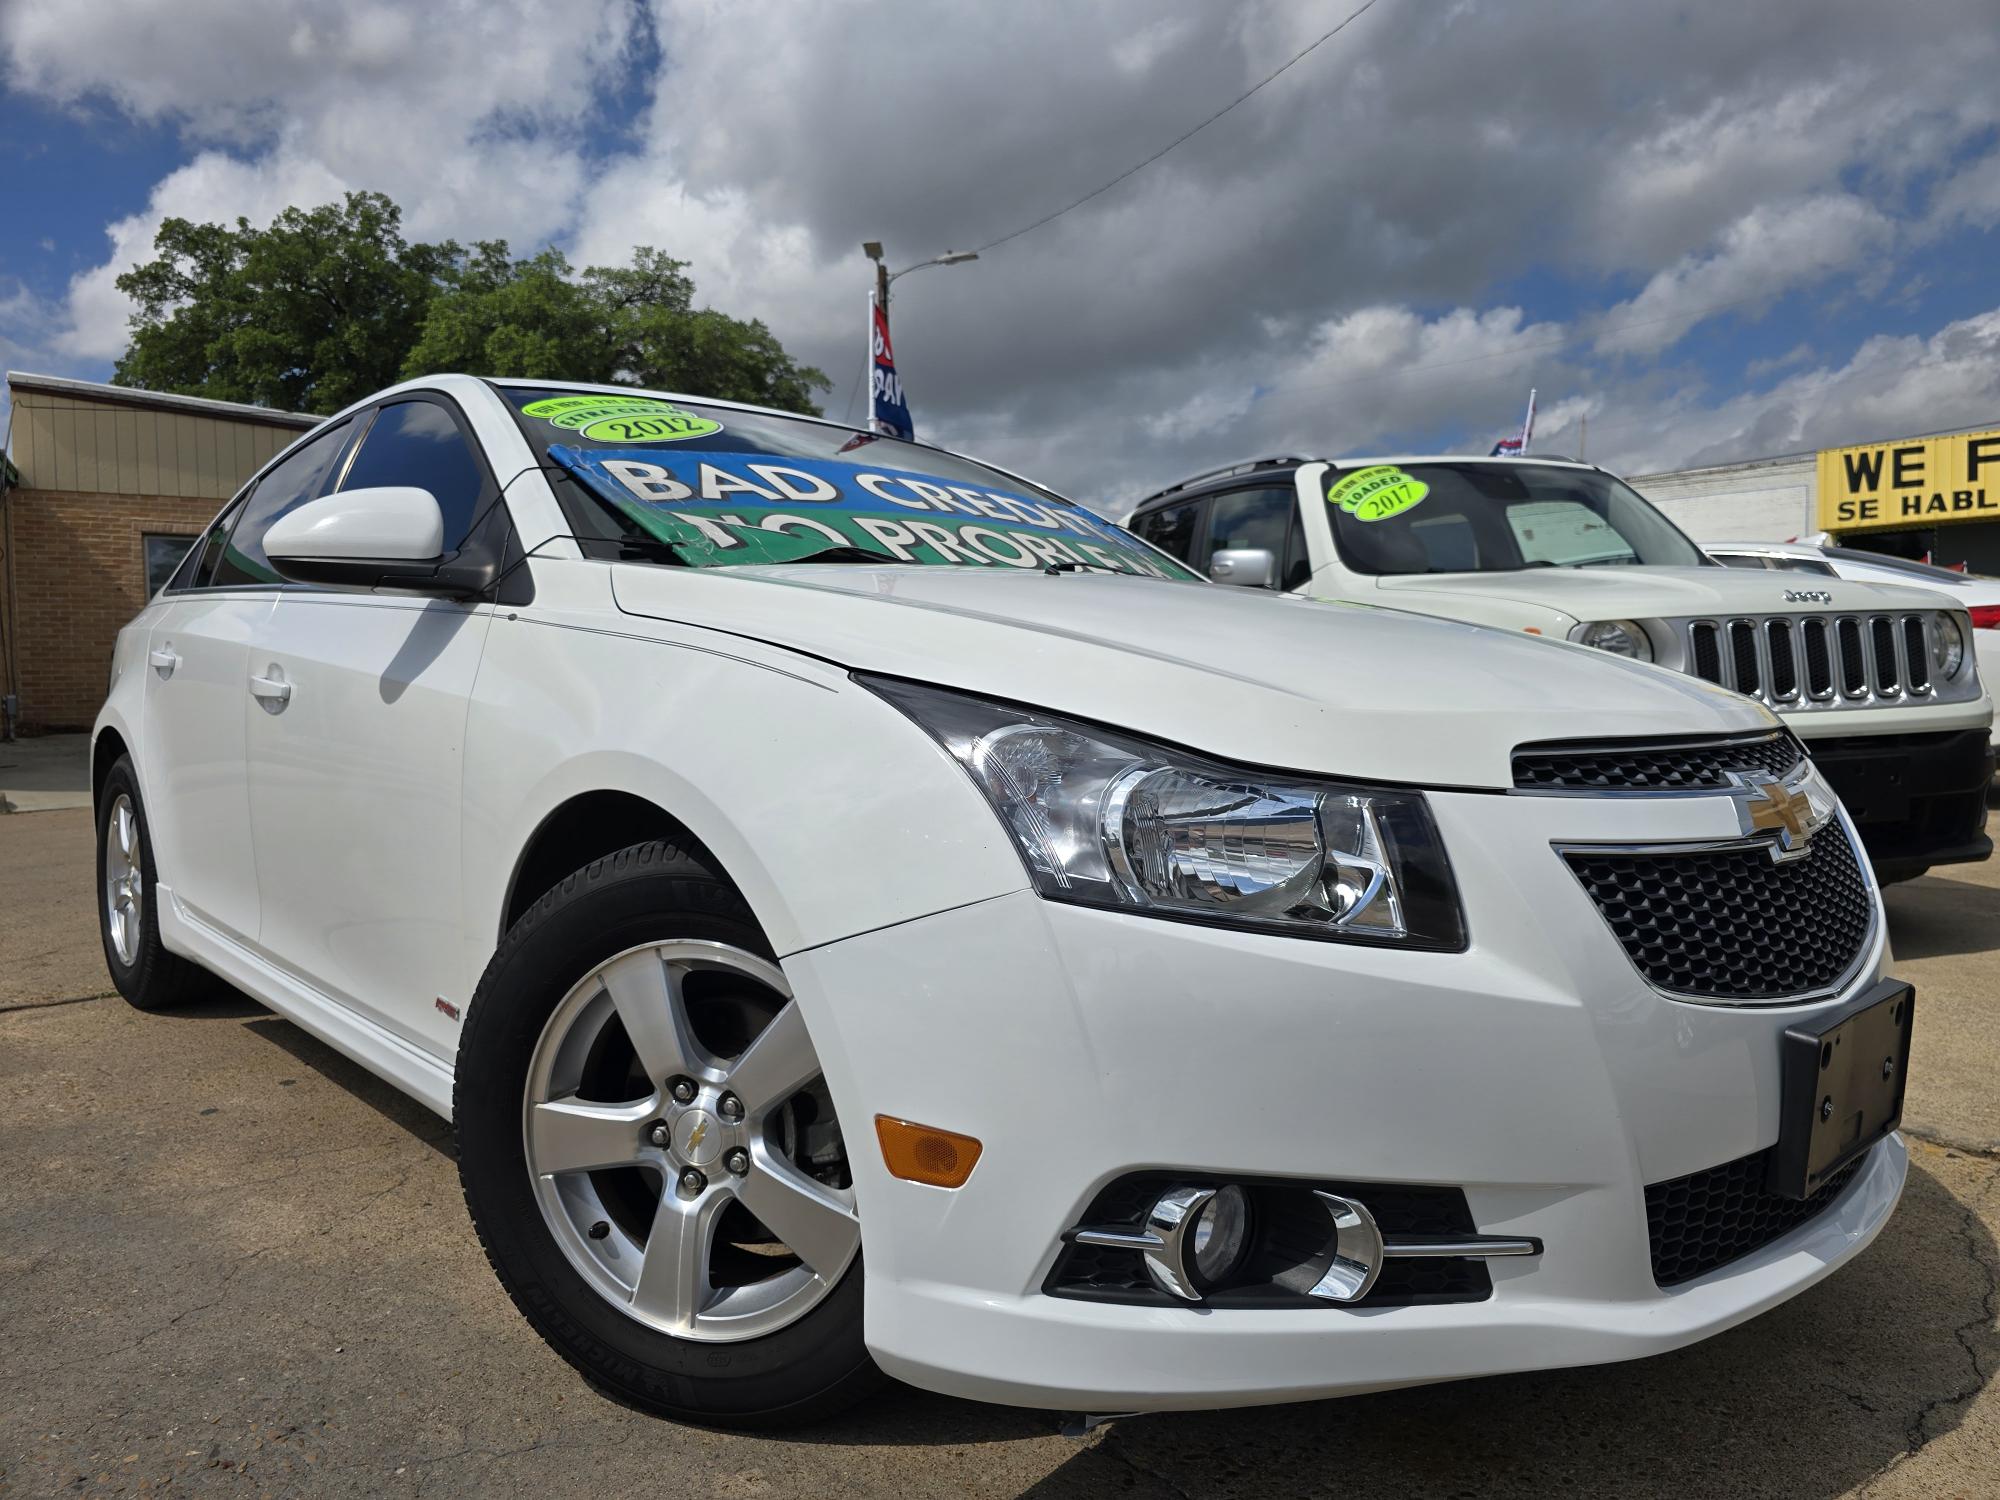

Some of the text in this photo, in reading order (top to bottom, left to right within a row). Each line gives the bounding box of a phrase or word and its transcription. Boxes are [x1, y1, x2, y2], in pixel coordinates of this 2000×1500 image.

[560, 408, 613, 427] EXTRA
[609, 416, 704, 440] 2012
[600, 460, 838, 501] BAD
[1844, 446, 1925, 494] WE
[1346, 476, 1402, 506] LOADED
[1368, 484, 1413, 517] 2017
[1837, 499, 1880, 521] SE
[1782, 589, 1832, 605] Jeep
